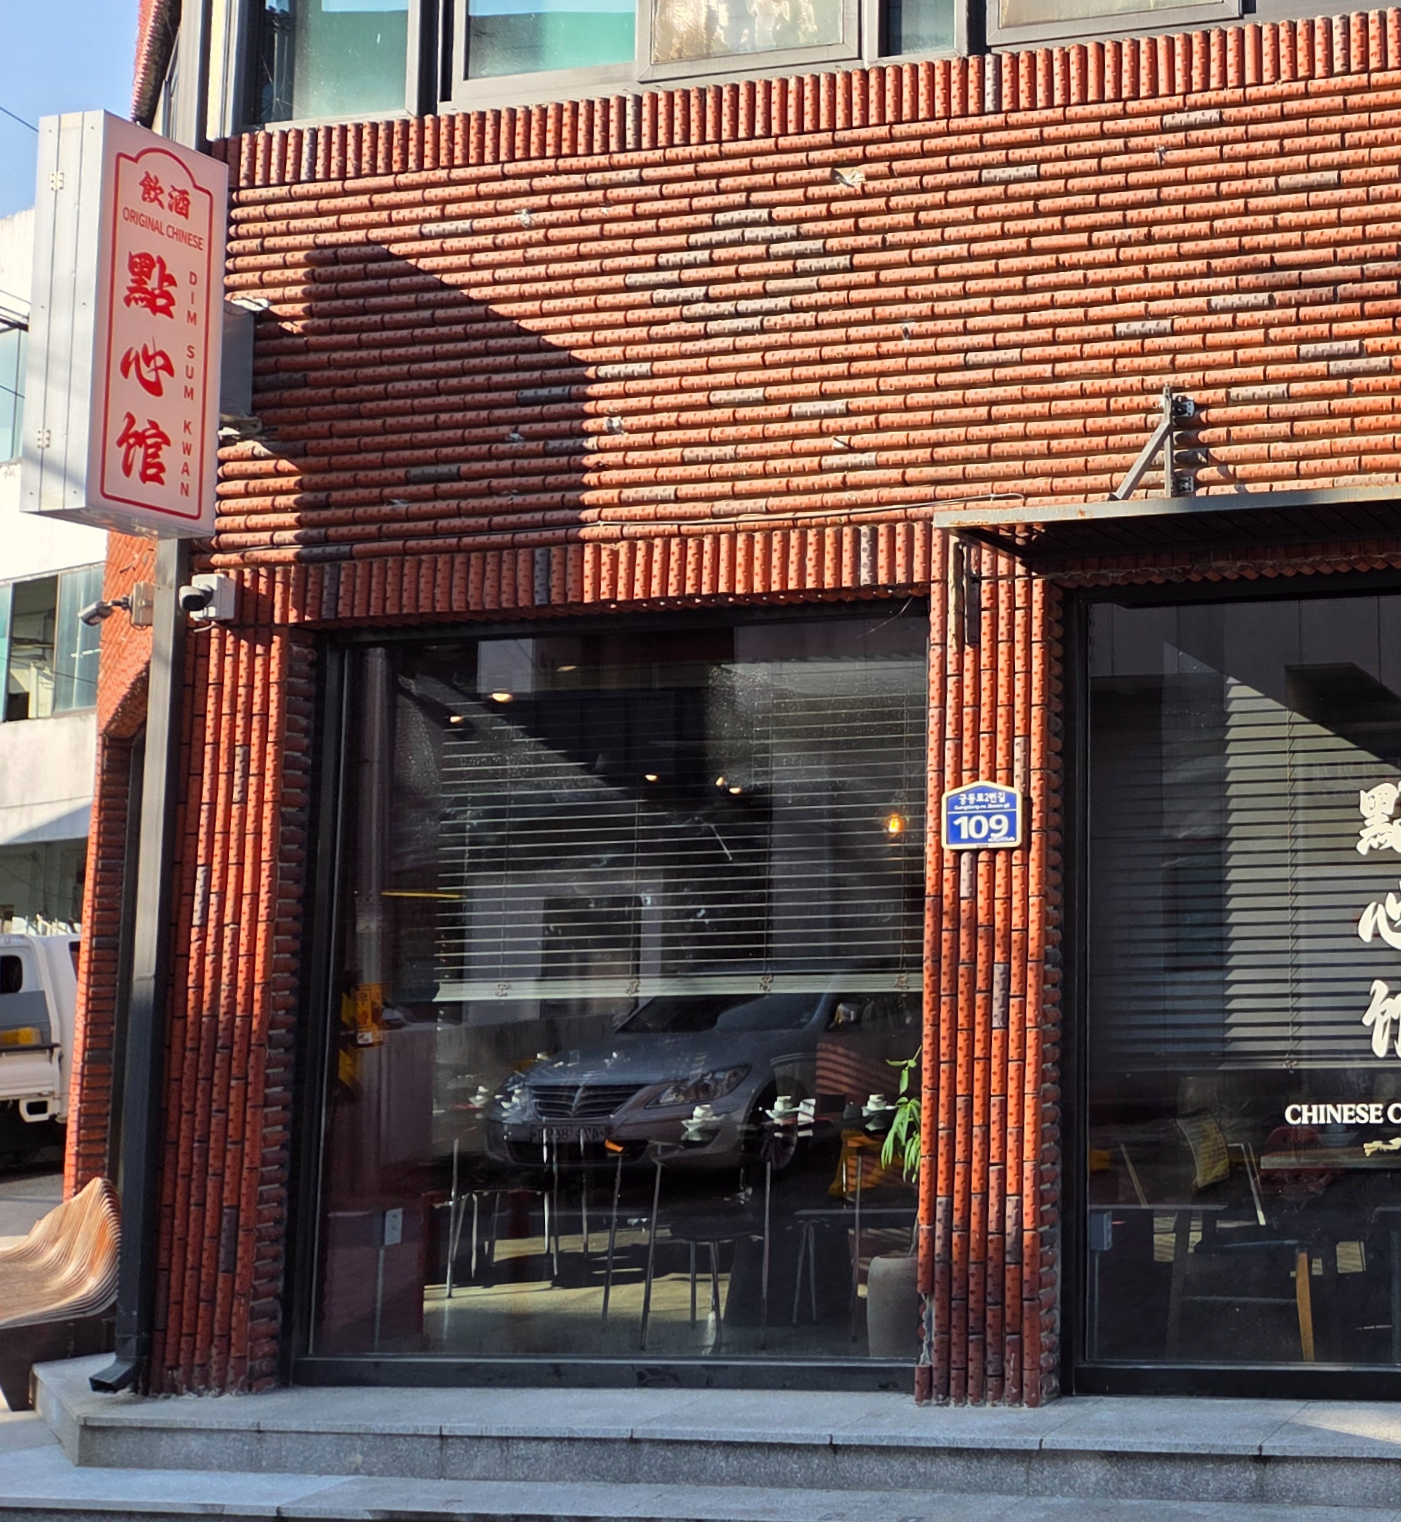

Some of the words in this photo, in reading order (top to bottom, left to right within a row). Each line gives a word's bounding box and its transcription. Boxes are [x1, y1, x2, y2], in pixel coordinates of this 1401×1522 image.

[122, 206, 165, 236] ORIGINAL
[165, 221, 204, 252] CHINESE
[186, 270, 197, 326] DIM
[183, 344, 195, 401] SUM
[180, 418, 192, 497] KWAN
[953, 814, 1009, 839] 109
[1284, 1103, 1384, 1126] CHINESE
